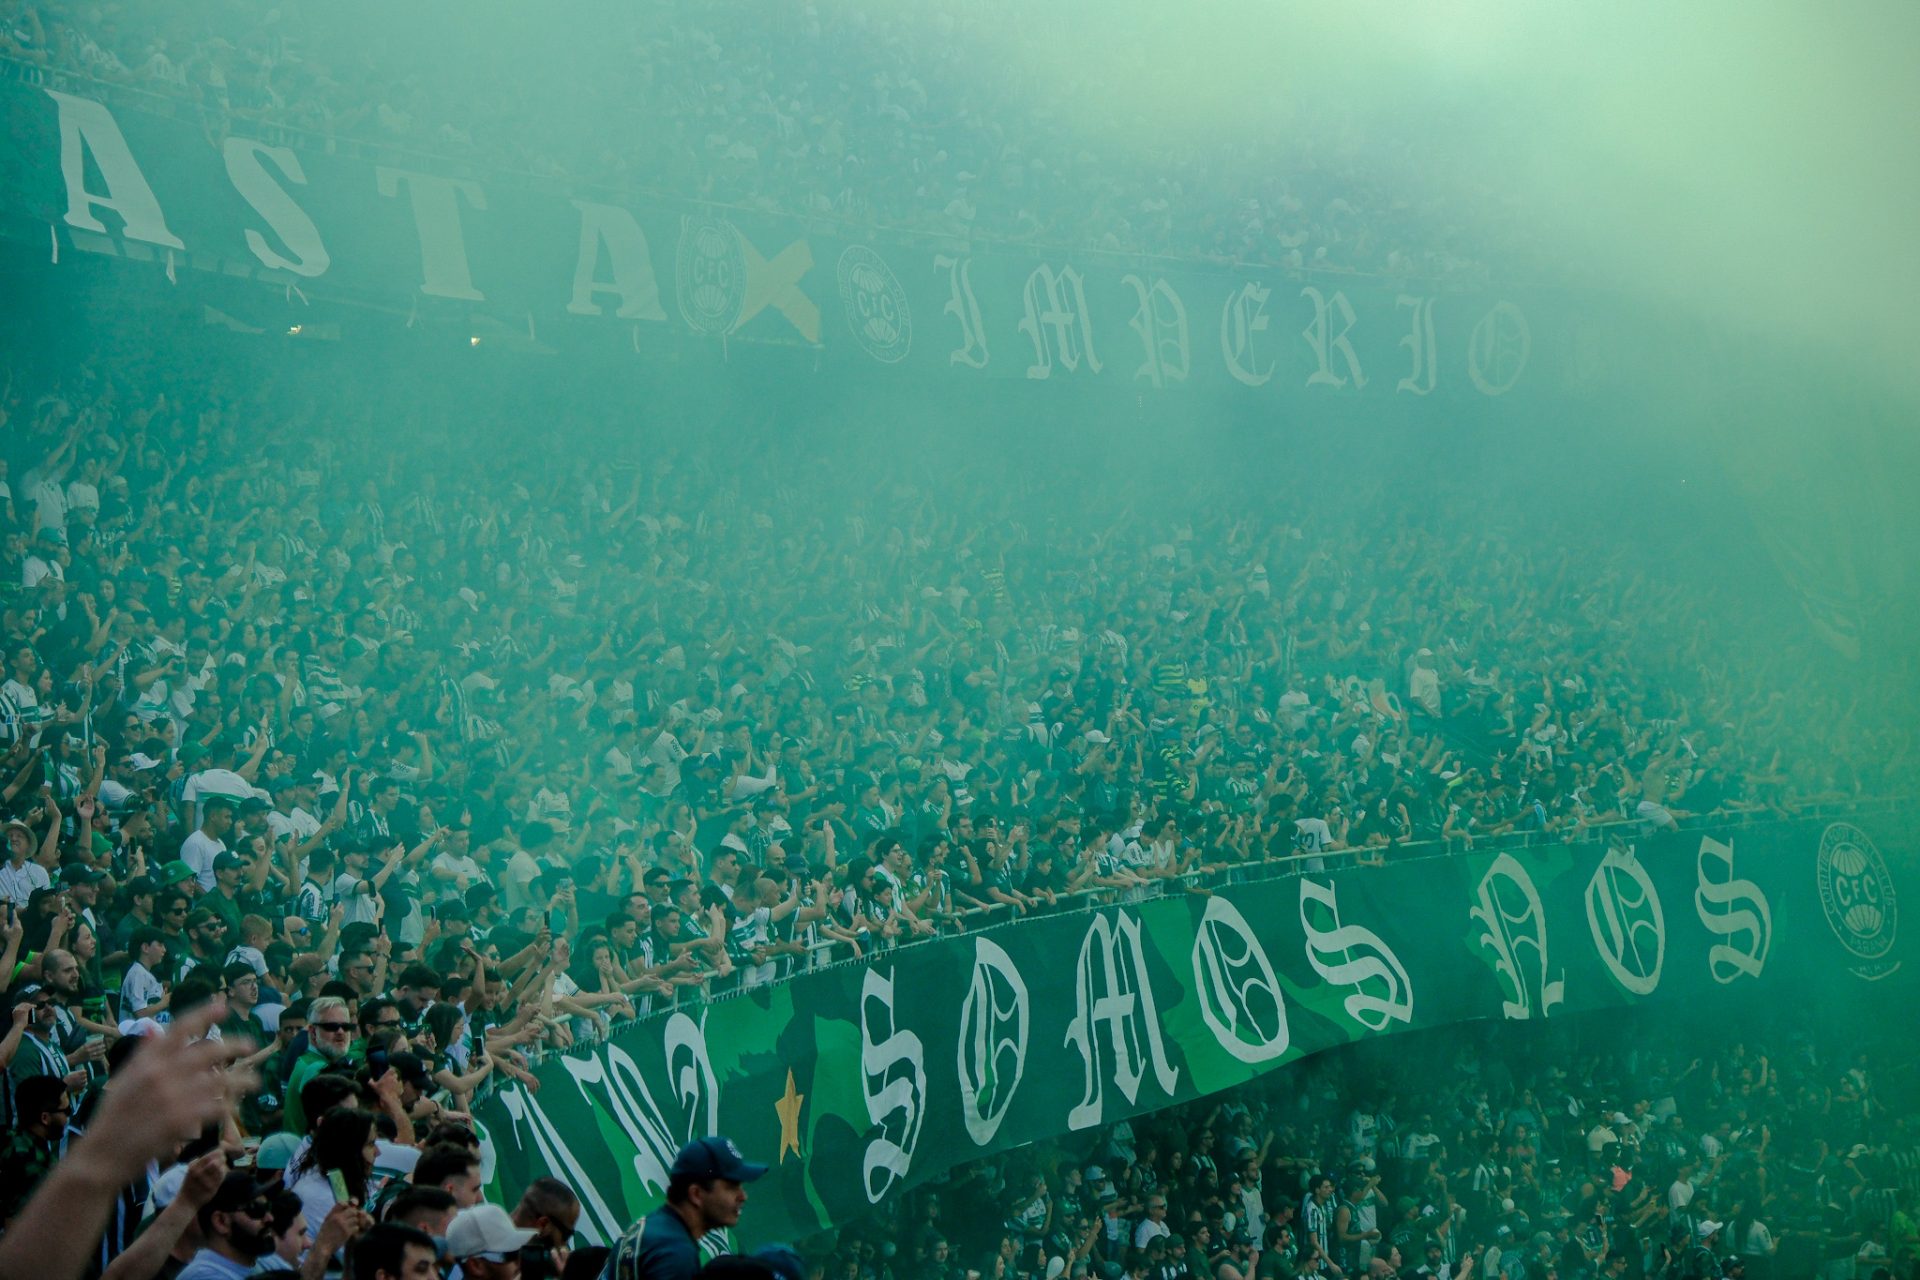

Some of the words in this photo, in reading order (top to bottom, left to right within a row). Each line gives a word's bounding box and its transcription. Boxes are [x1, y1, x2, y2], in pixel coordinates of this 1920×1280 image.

[694, 256, 728, 288] CFC
[1836, 874, 1877, 906] CFC
[861, 879, 1413, 1204] SOMOS
